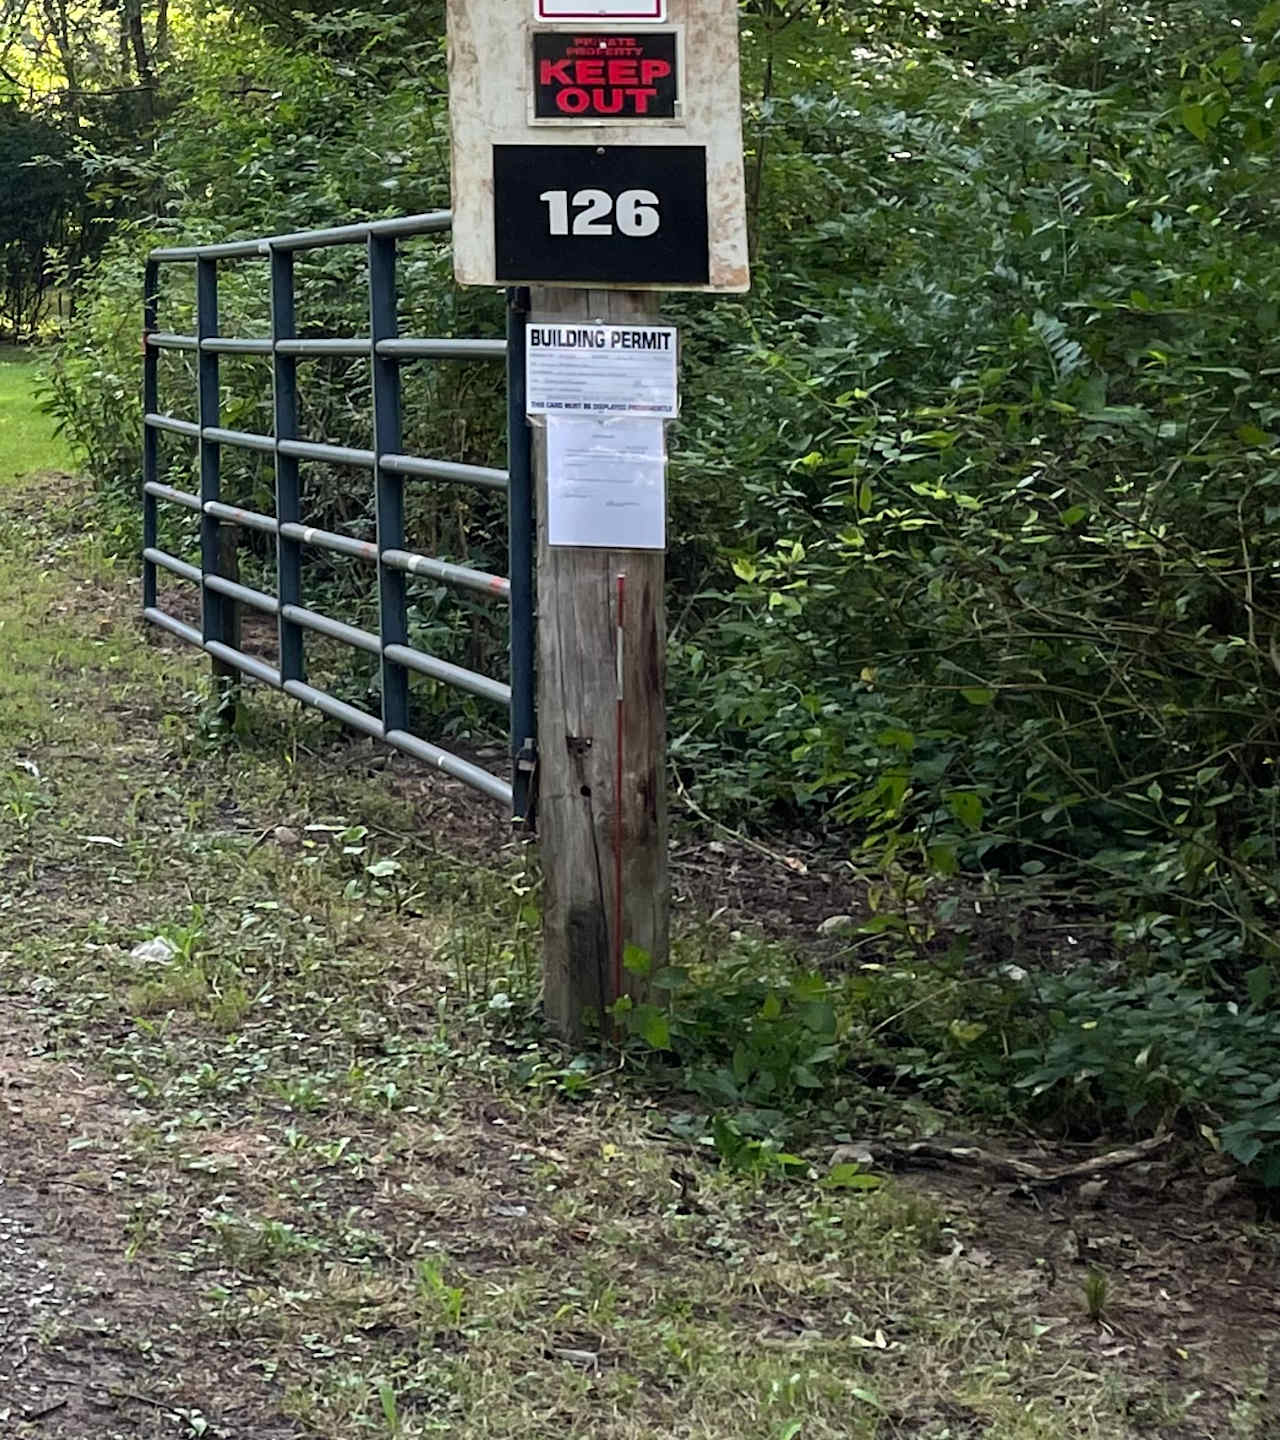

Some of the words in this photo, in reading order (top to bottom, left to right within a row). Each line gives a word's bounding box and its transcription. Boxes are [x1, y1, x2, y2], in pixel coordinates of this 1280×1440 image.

[540, 59, 670, 85] KEEP
[556, 88, 656, 113] OUT
[540, 189, 660, 236] 126
[531, 328, 605, 348] BUILDING
[611, 331, 671, 350] PERMIT
